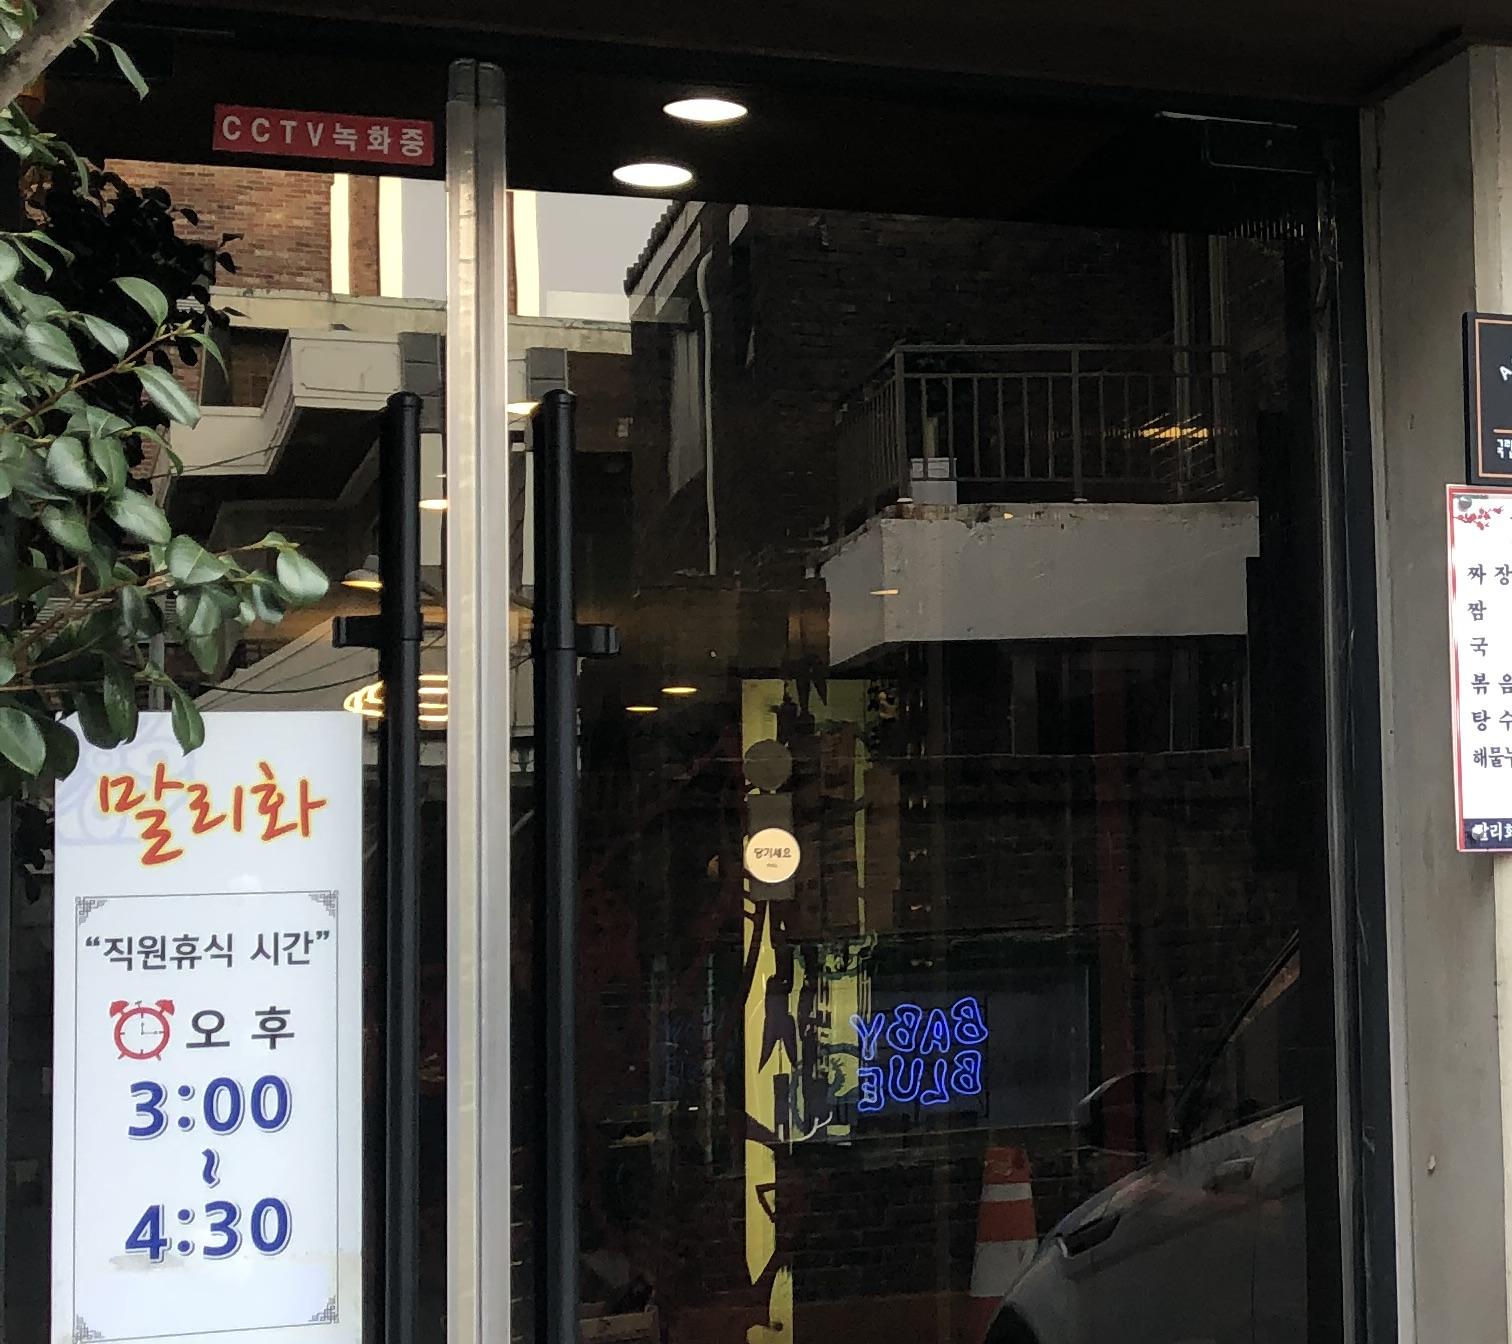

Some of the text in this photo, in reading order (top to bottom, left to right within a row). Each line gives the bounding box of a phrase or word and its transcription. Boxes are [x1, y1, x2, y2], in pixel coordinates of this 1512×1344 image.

[98, 760, 328, 867] 말리화
[128, 1074, 293, 1142] 3:00
[125, 1197, 293, 1264] 4:30
